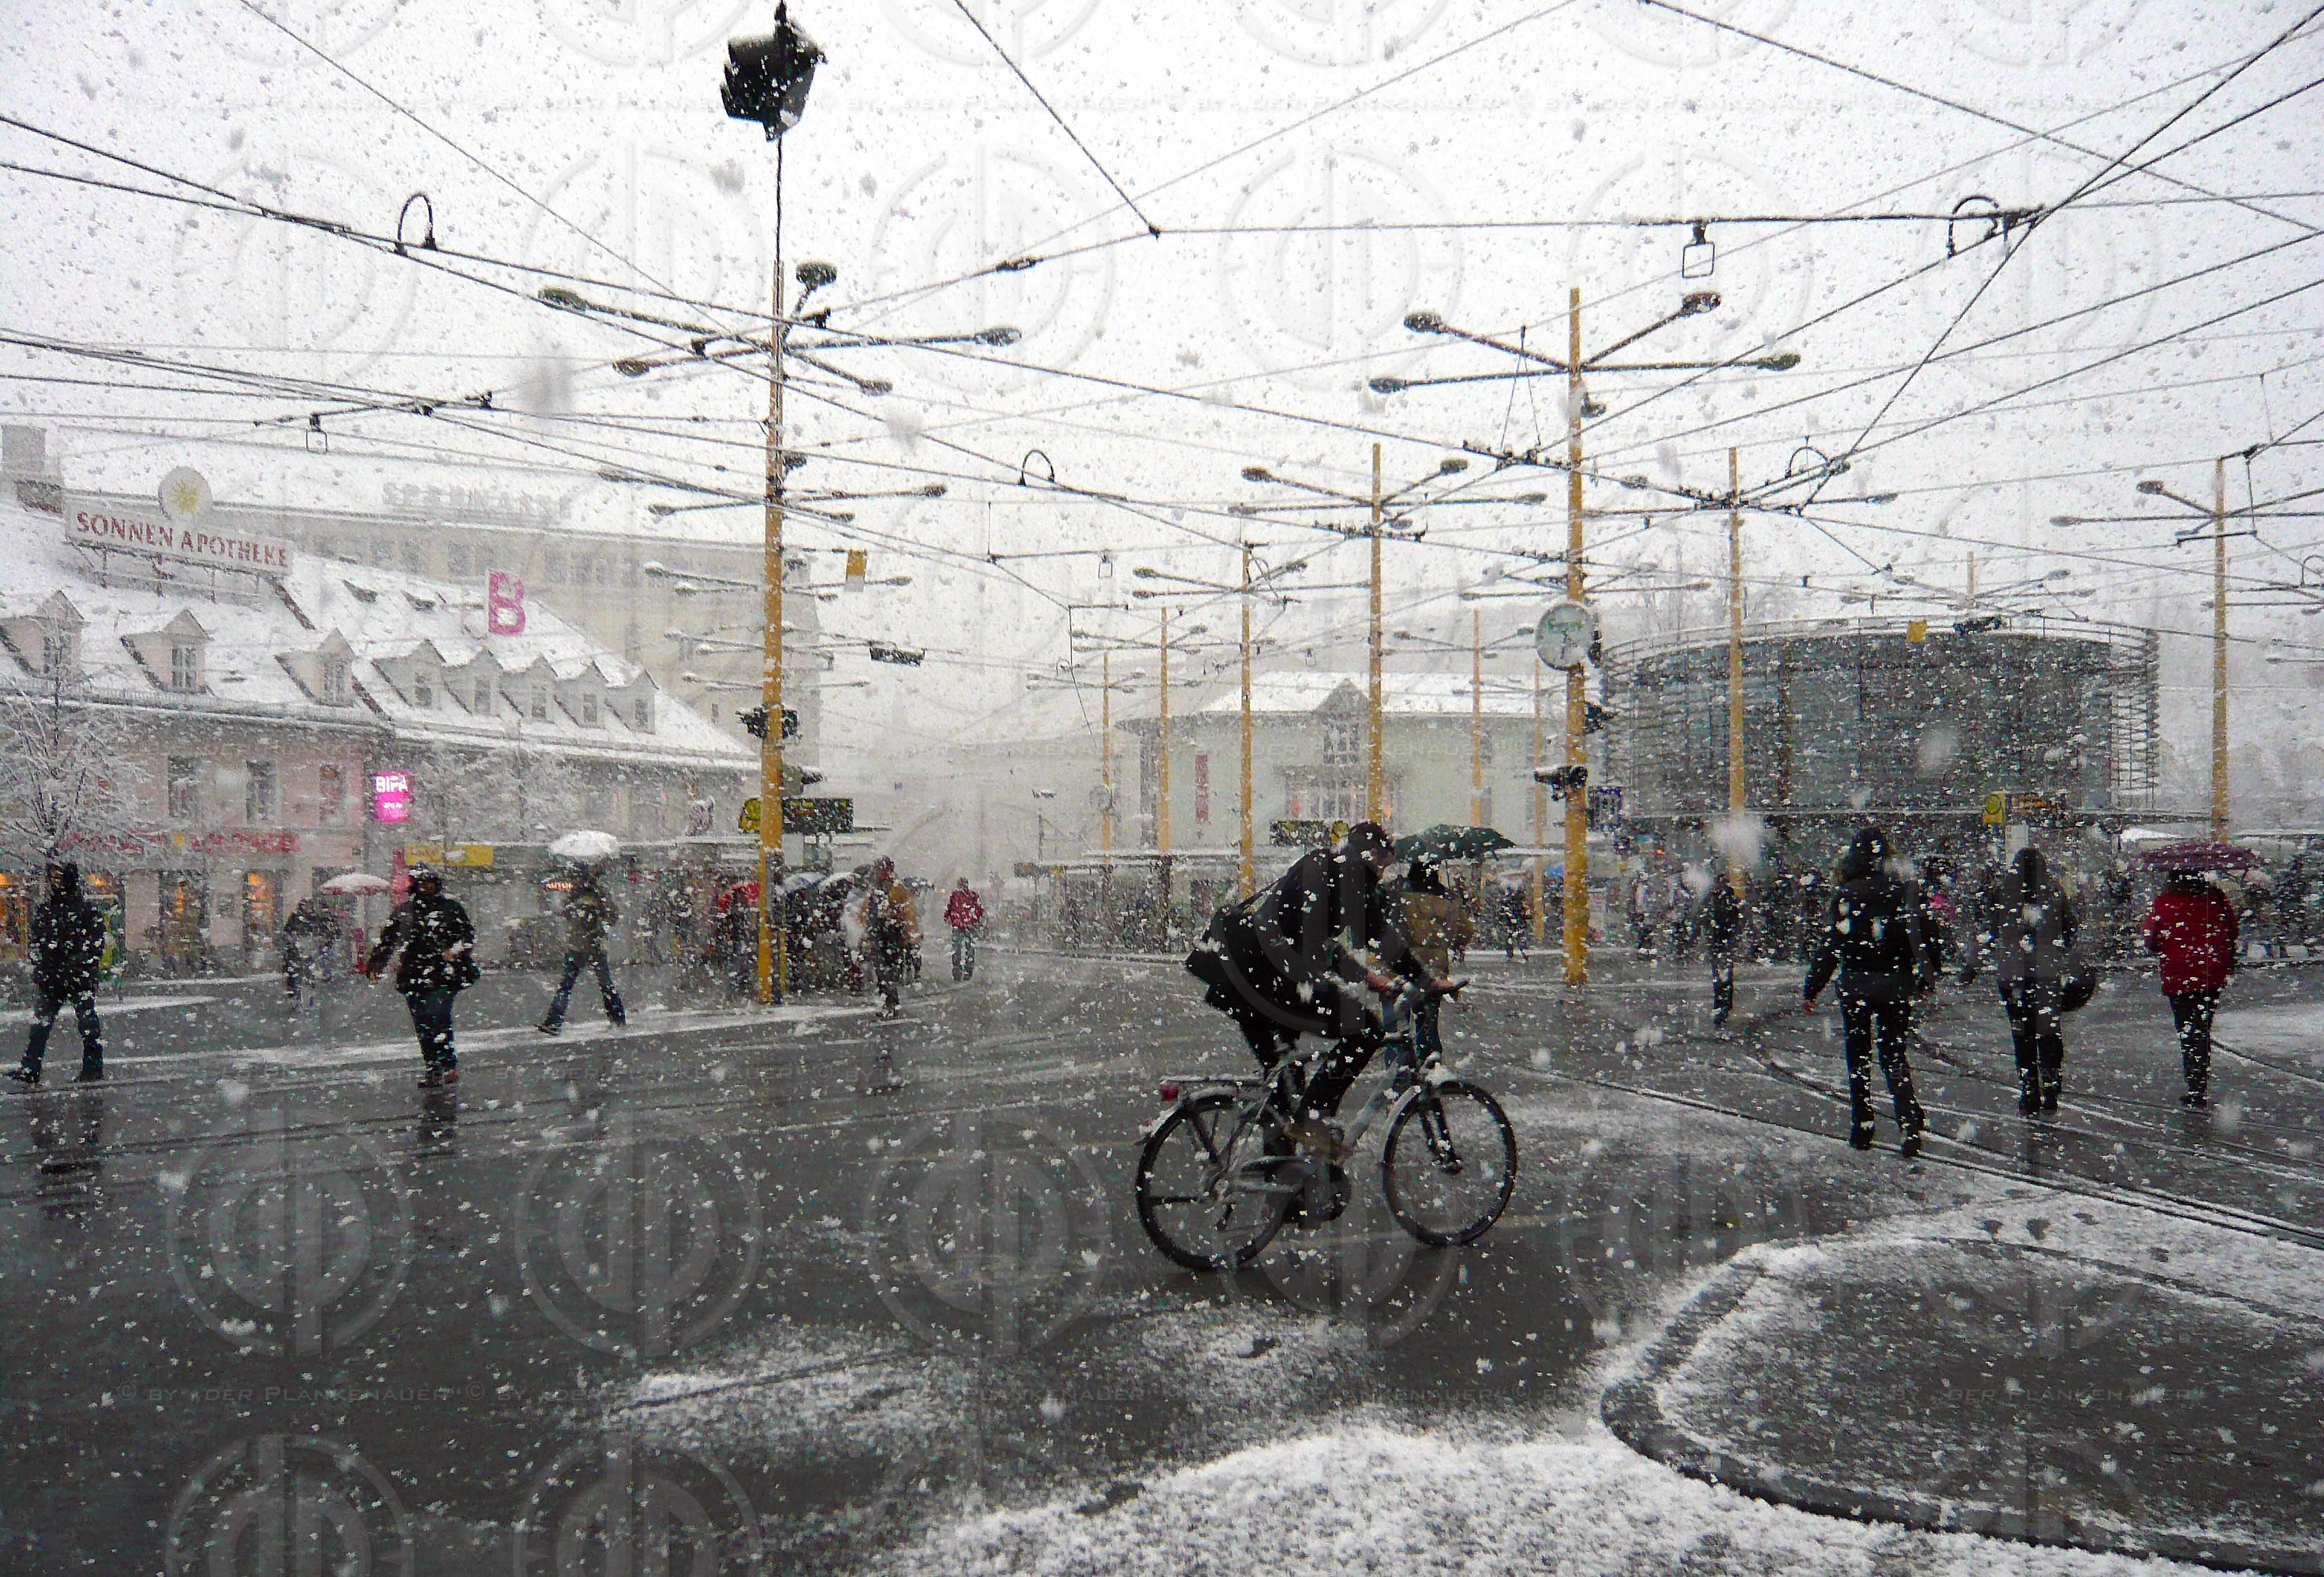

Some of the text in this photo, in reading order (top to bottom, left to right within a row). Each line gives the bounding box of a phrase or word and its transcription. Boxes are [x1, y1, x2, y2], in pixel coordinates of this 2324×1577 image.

[77, 512, 288, 568] SONNEN APOTHEKE
[488, 571, 526, 635] B
